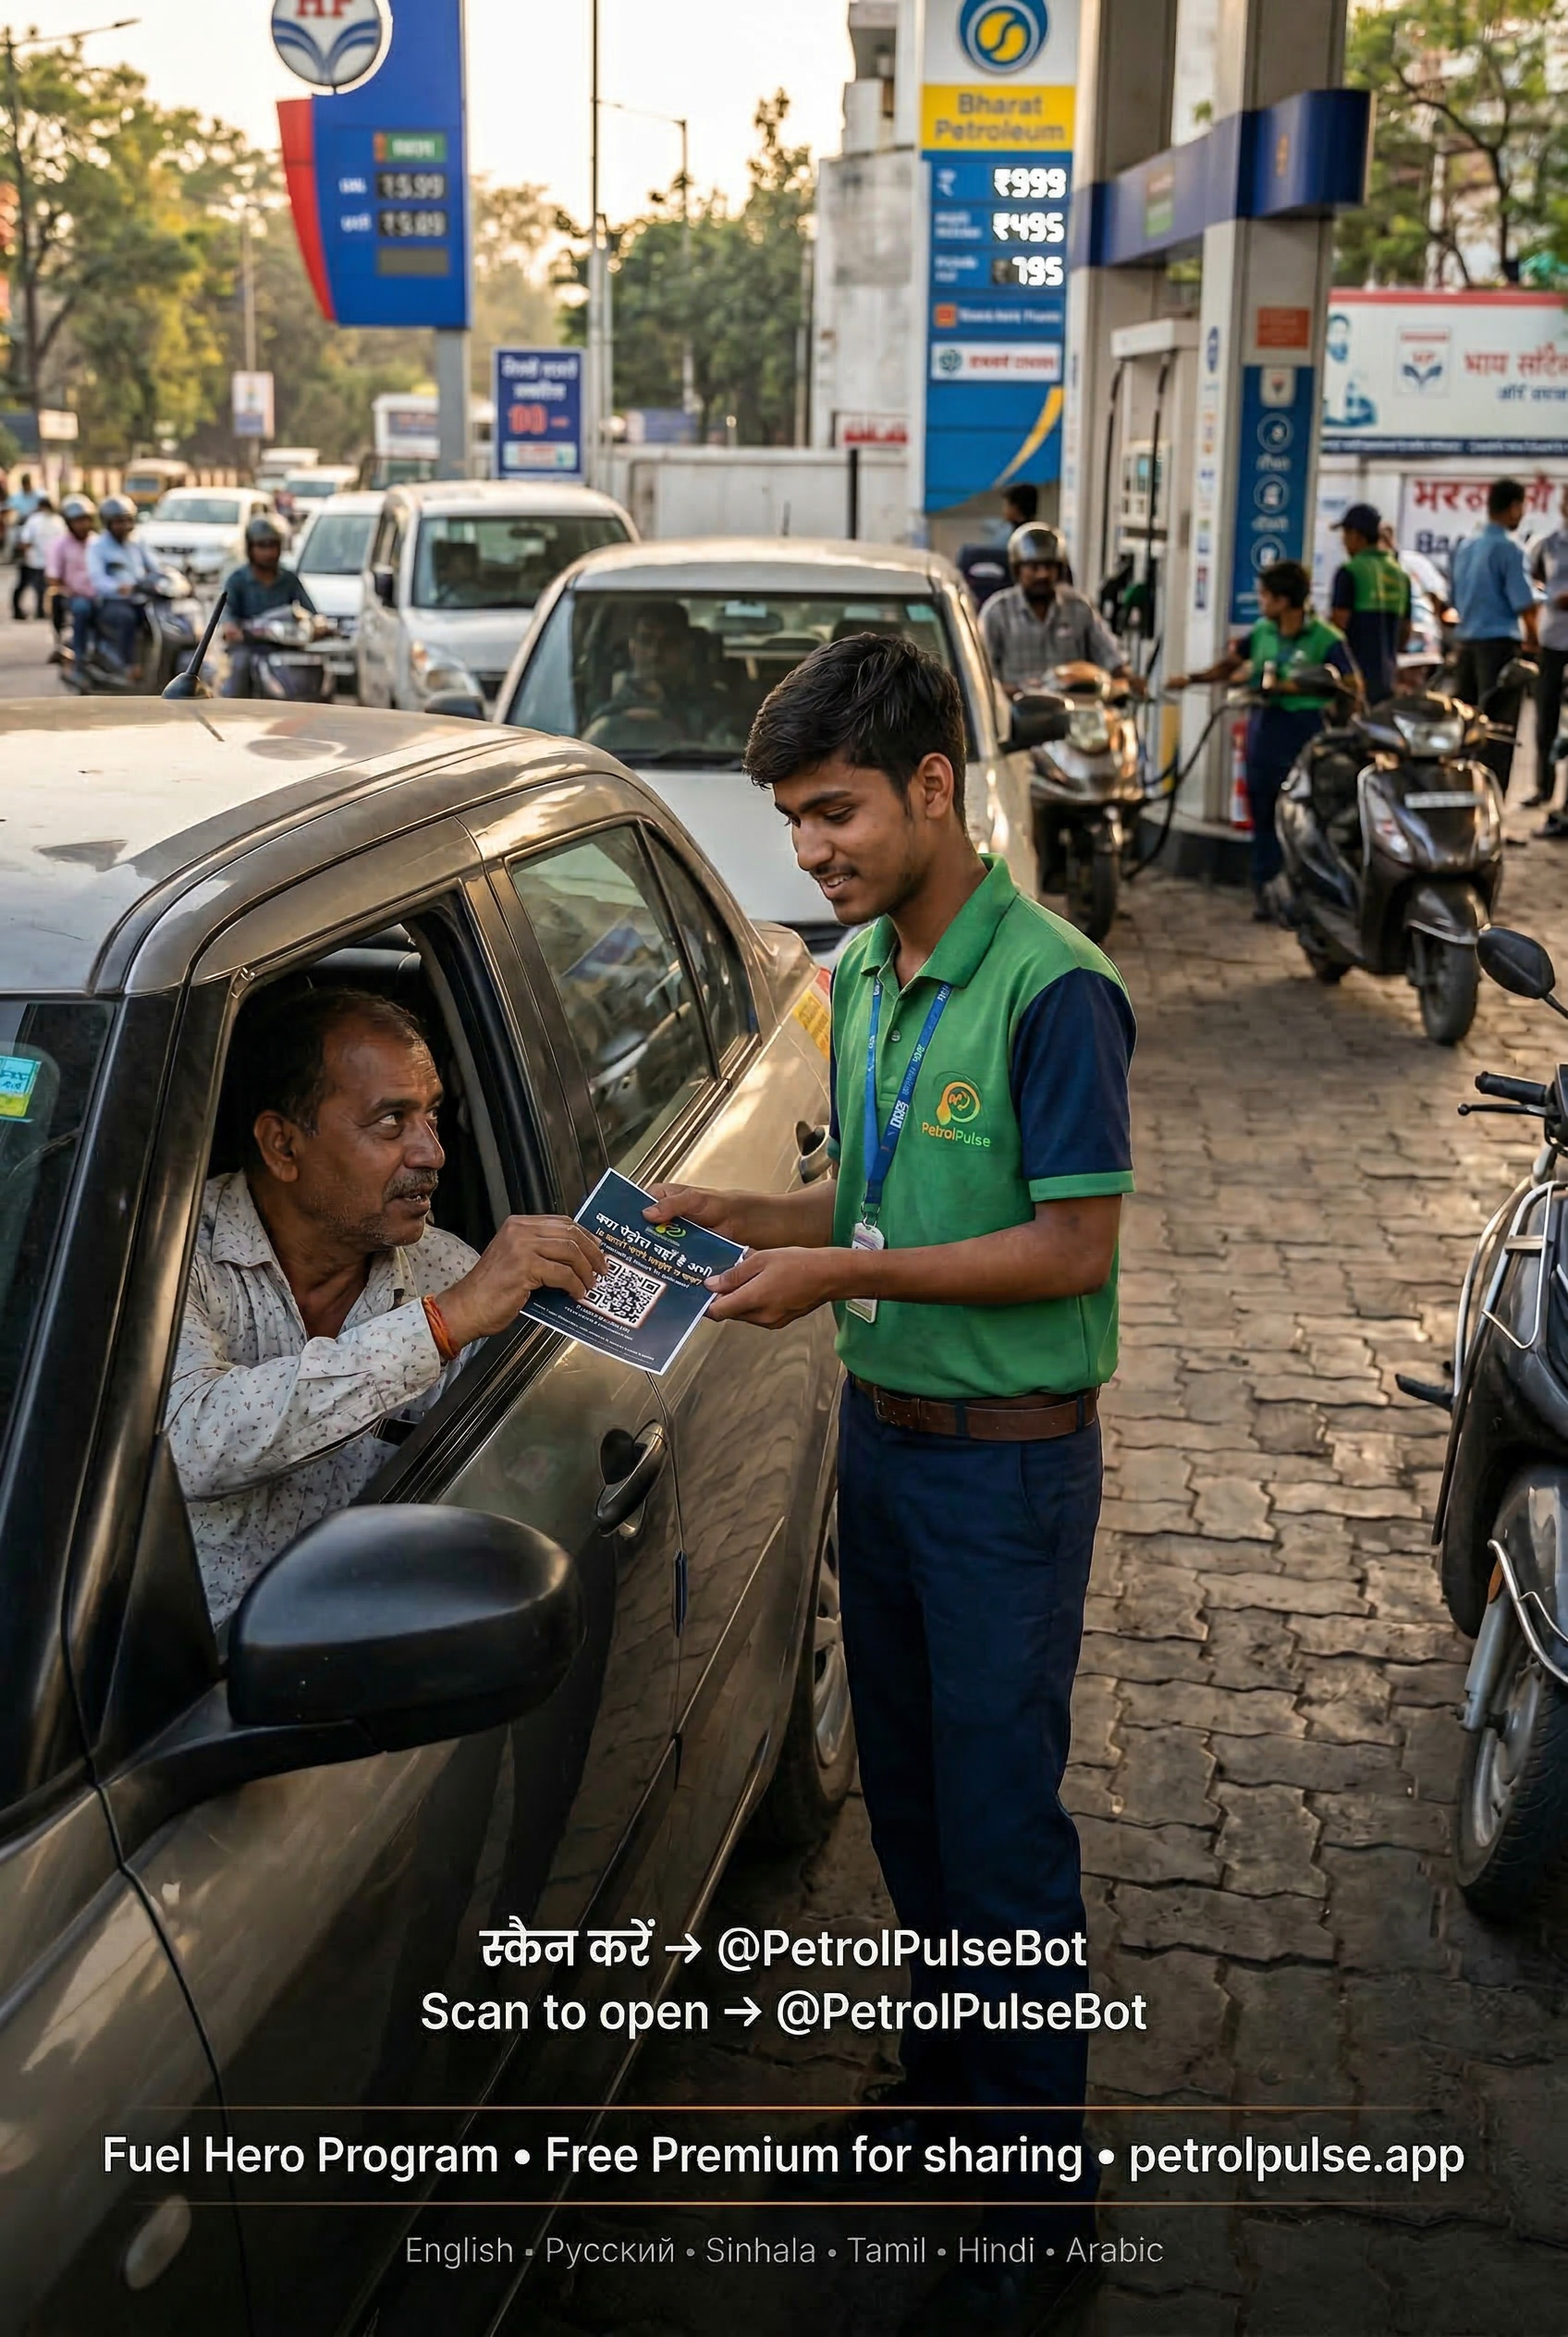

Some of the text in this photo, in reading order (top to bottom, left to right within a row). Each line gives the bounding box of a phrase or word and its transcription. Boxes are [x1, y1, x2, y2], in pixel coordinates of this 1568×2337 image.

[957, 93, 1043, 116] Bharat
[935, 118, 1066, 141] Petroleum
[922, 1121, 991, 1147] PetrolPulse
